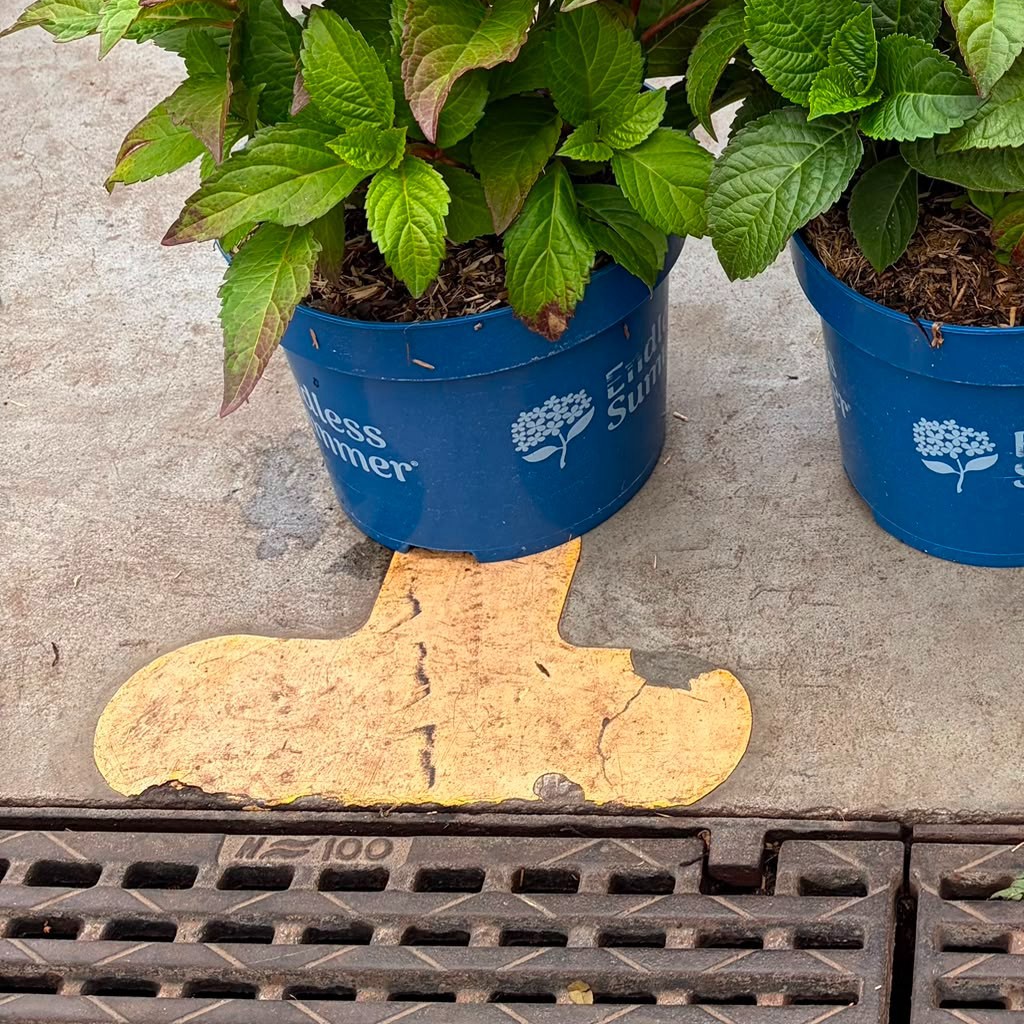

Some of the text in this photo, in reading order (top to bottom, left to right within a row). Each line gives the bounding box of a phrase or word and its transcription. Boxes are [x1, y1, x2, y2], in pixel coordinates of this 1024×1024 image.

[606, 312, 668, 400] Endl
[300, 384, 387, 449] dless
[312, 418, 413, 482] mmer
